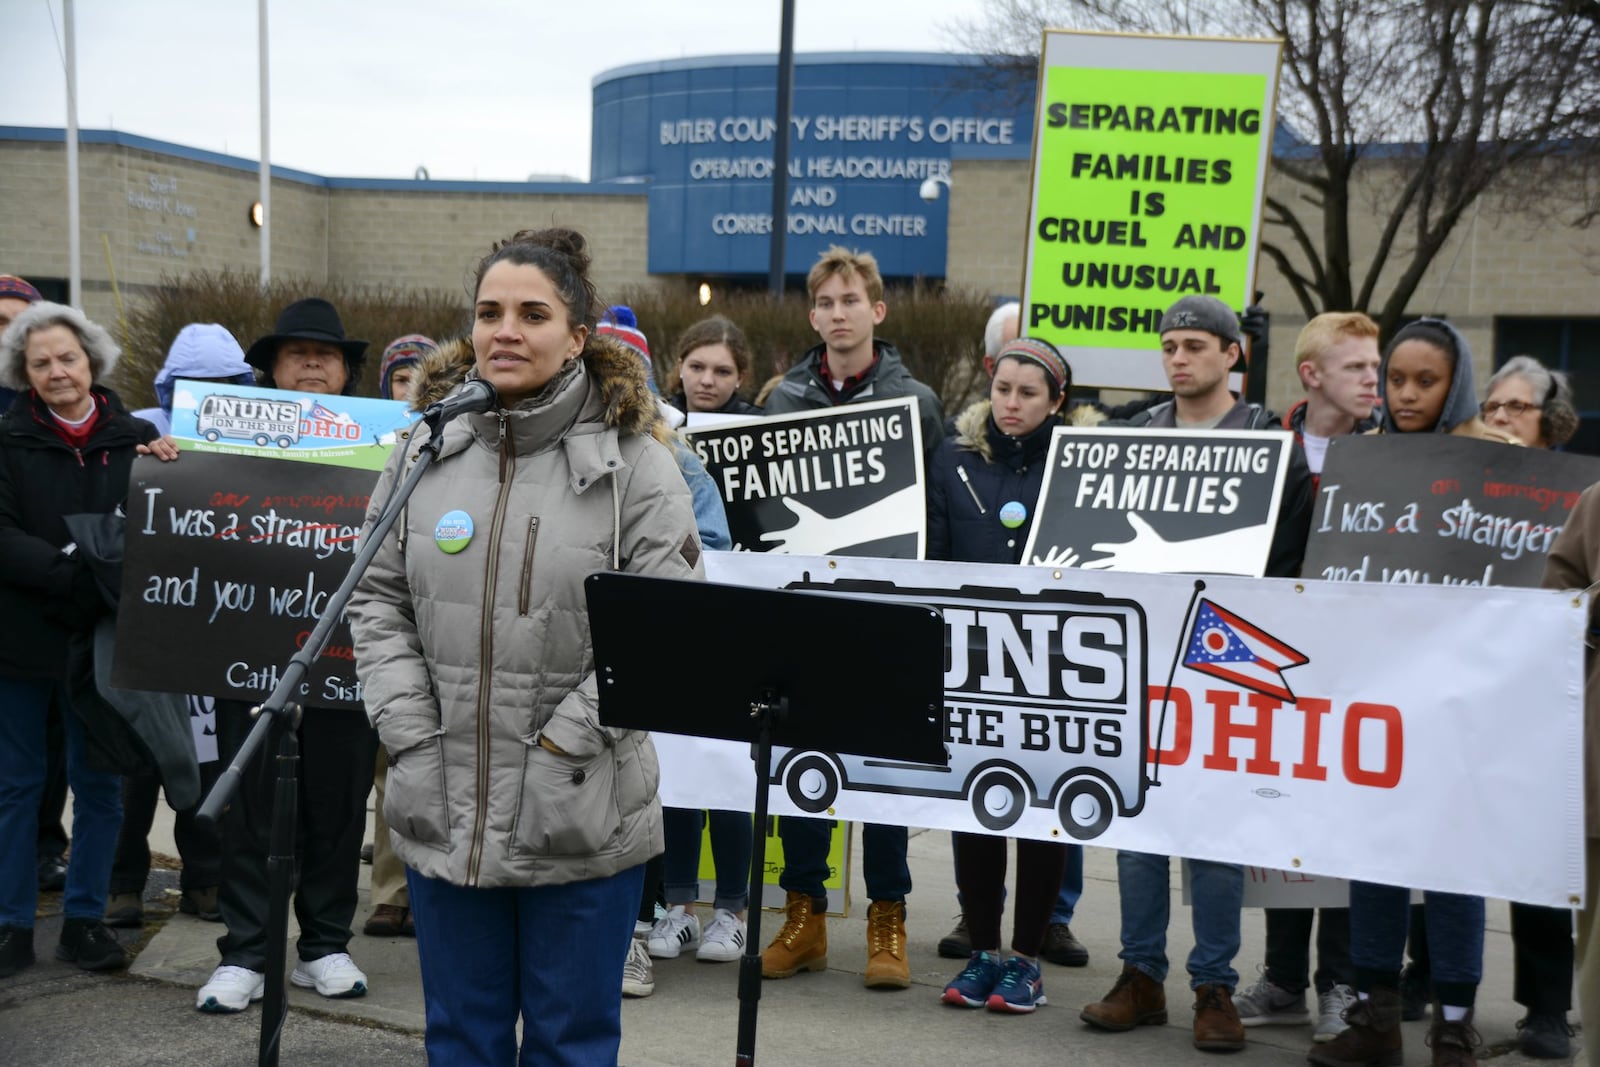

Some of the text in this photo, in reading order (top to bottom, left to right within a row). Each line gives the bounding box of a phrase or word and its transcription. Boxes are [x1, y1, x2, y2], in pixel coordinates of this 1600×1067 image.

[660, 115, 1014, 145] BUTLER COUNY SHERIFF'S OFFICE
[1047, 103, 1260, 135] SEPARATING
[1071, 153, 1232, 184] FAMILIES
[790, 186, 837, 207] AND
[1130, 190, 1165, 217] IS
[711, 213, 926, 236] CORRECIONAL CENTER
[1038, 217, 1246, 250] CRUEL AND
[1062, 262, 1221, 294] UNUSUAL
[1030, 303, 1163, 334] PUNISH
[215, 418, 295, 434] ON THE BUS
[217, 399, 297, 423] NUNS
[299, 418, 361, 440] OHIO
[696, 414, 904, 465] STOP SEPARATING
[723, 446, 886, 502] FAMILIES
[1060, 442, 1270, 474] STOP SEPARATING
[1074, 472, 1242, 515] FAMILIES
[141, 487, 361, 560] I was a stranger
[1317, 485, 1565, 560] I was a stranger
[143, 566, 200, 606] and
[207, 580, 256, 624] you
[226, 661, 310, 695] Cathc
[943, 706, 1123, 758] HE BUS
[1147, 684, 1403, 788] OHIO
